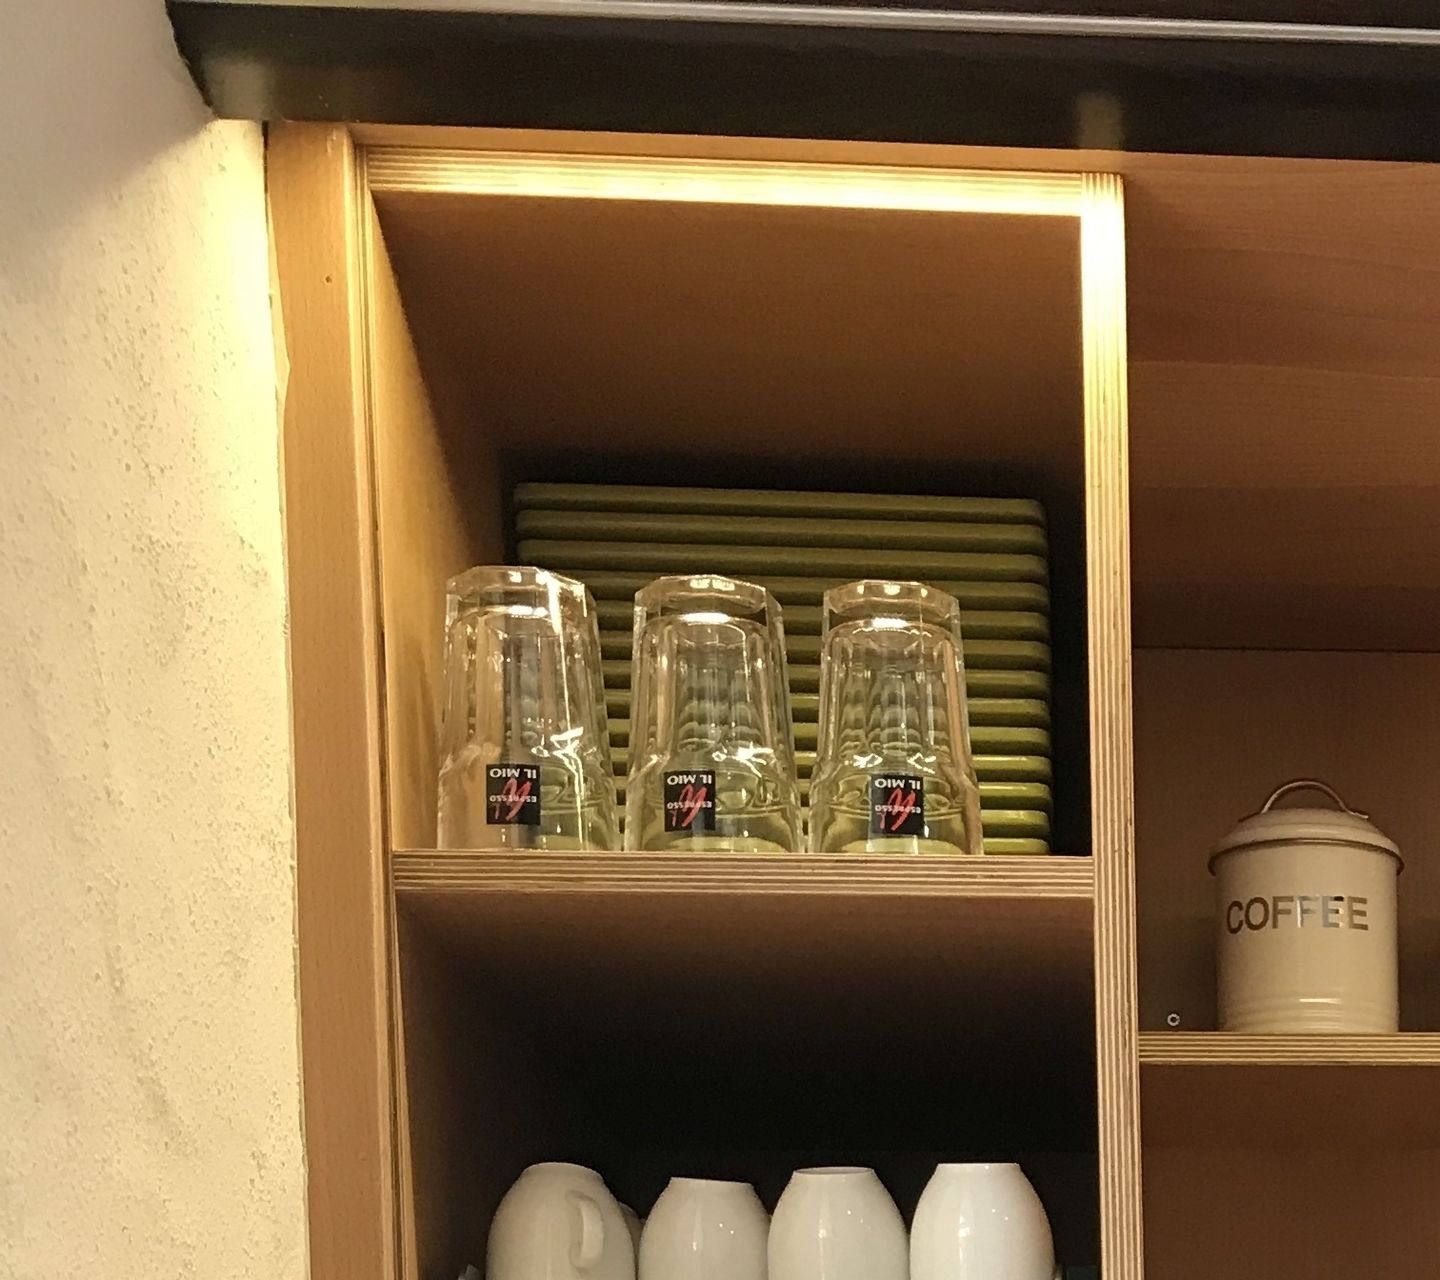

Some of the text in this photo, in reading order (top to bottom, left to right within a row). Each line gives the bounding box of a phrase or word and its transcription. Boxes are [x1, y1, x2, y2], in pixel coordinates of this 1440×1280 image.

[490, 768, 537, 779] IL MIO
[667, 774, 713, 785] IL MIO
[874, 778, 922, 789] IL MIO
[1226, 895, 1370, 935] COFFEE
